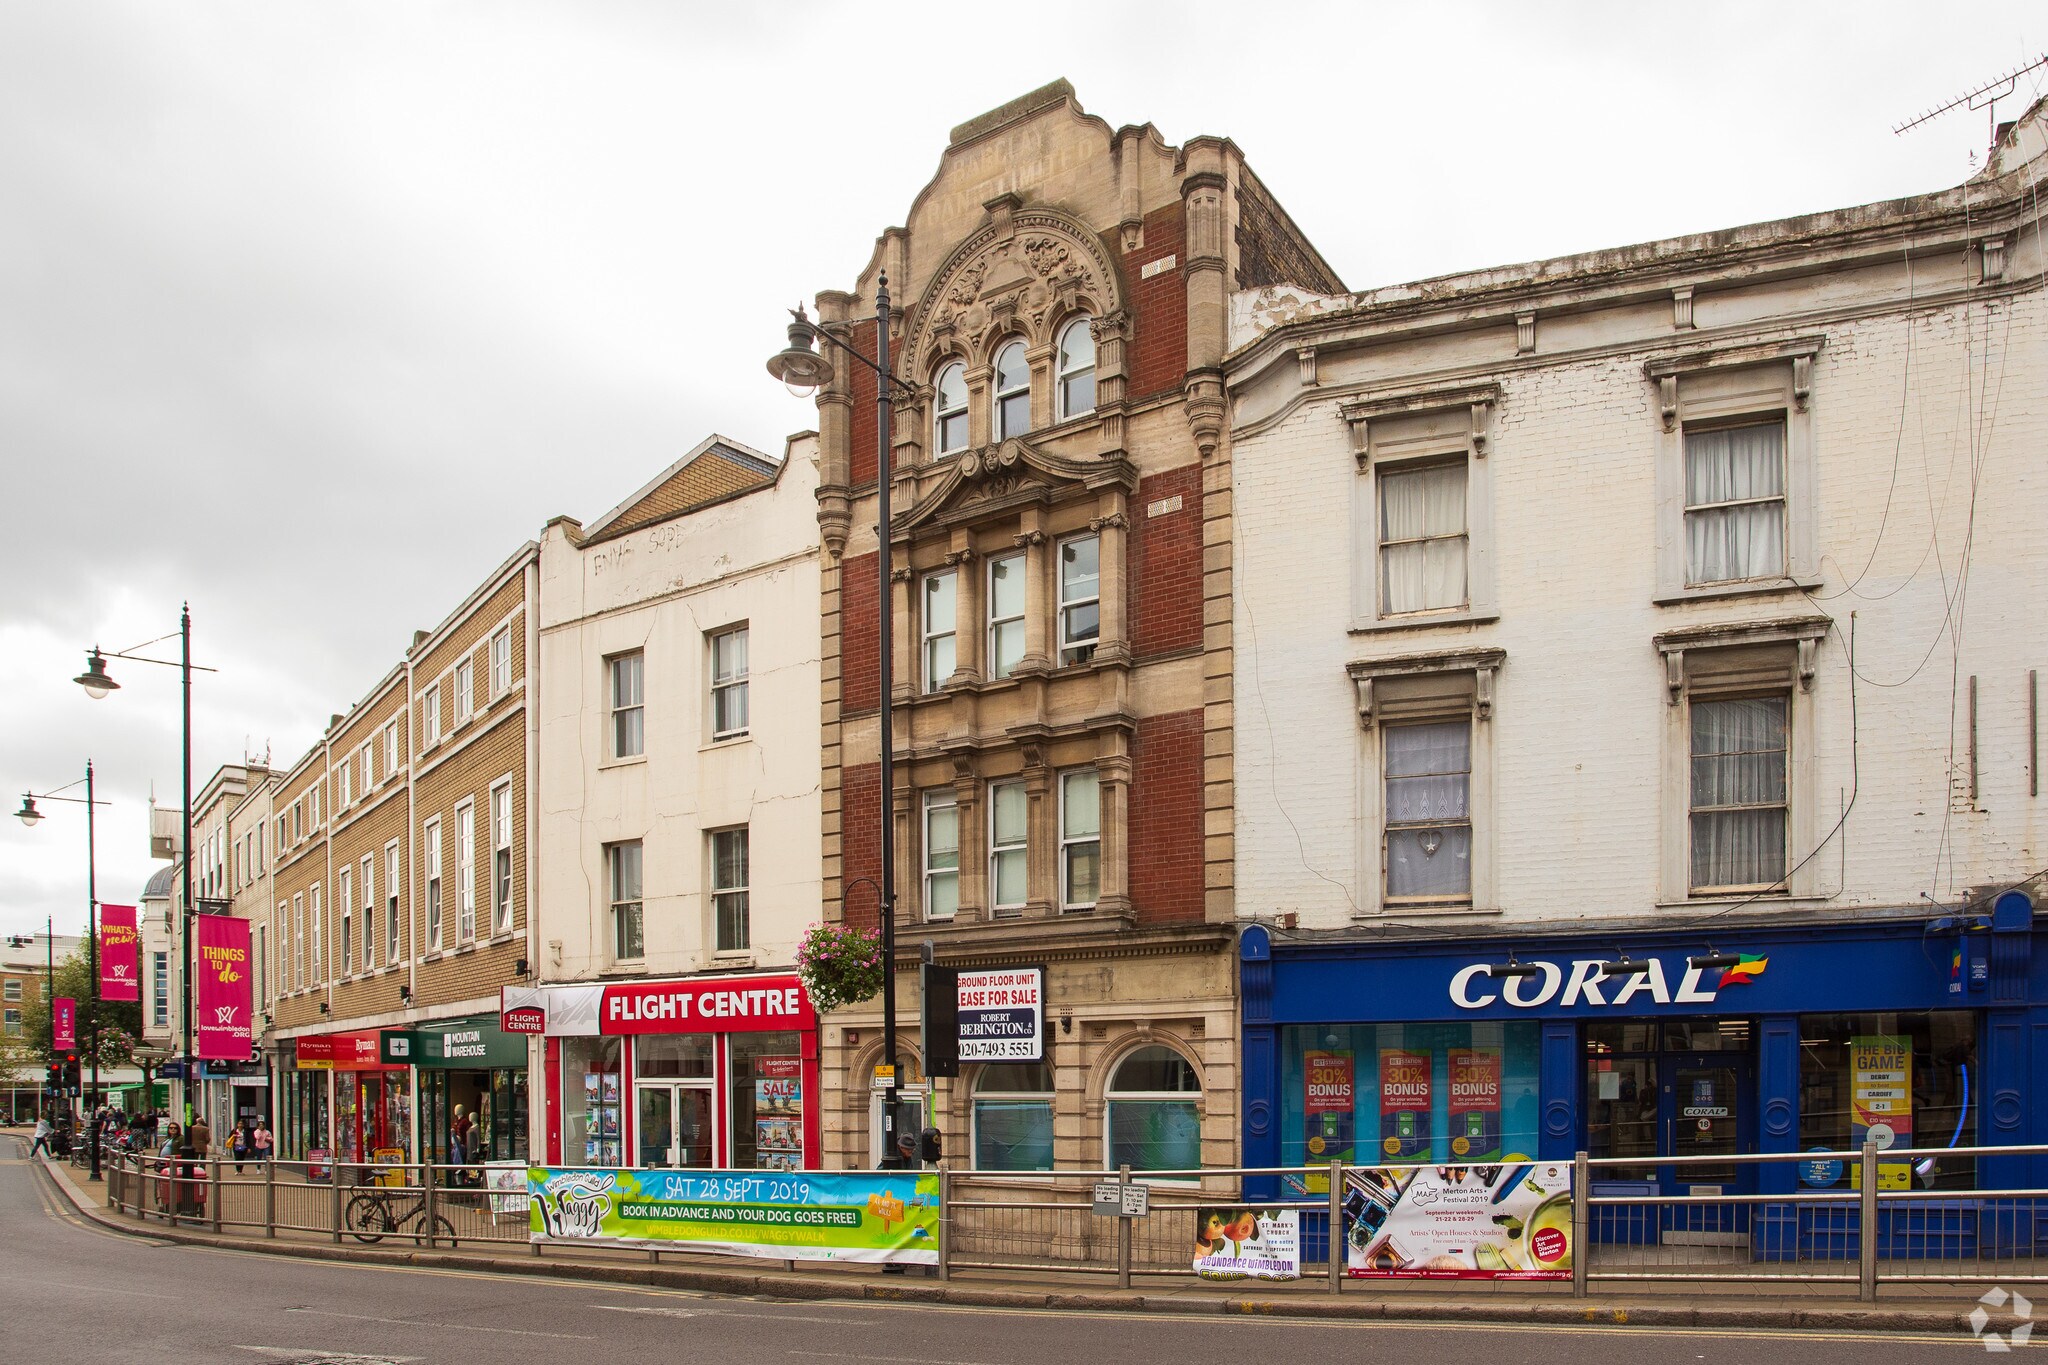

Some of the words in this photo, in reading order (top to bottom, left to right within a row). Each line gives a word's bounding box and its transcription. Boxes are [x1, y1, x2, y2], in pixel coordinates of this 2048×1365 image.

[102, 925, 132, 934] WHAT'S
[106, 933, 136, 946] new?
[202, 946, 245, 961] THINGS
[211, 960, 222, 969] TO
[219, 963, 242, 983] do
[957, 977, 987, 987] GROUND
[990, 976, 1014, 986] FLOOR
[1016, 974, 1035, 985] UNIT
[1449, 957, 1717, 1008] CORAL
[609, 994, 693, 1020] FLIGHT
[698, 989, 800, 1017] CENTRE
[958, 991, 985, 1007] EASE
[988, 991, 1008, 1005] FOR
[1011, 989, 1037, 1005] SALE
[509, 1015, 540, 1023] FLIGHT
[980, 1013, 1010, 1022] ROBERT
[508, 1022, 541, 1030] CENTRE
[960, 1022, 1024, 1035] BEBINGTON
[452, 1031, 480, 1043] MOUNTAIN
[355, 1039, 376, 1053] Ryman
[452, 1044, 486, 1057] WAREHOUSE
[959, 1042, 1006, 1057] 020-7493
[1009, 1042, 1034, 1056] 5551
[1857, 1045, 1879, 1055] THE
[1884, 1045, 1906, 1055] BIG
[1857, 1056, 1905, 1070] GAME
[1312, 1068, 1347, 1084] 30%
[1387, 1067, 1424, 1083] 30%
[1455, 1067, 1493, 1083] 30%
[763, 1082, 795, 1096] SALE
[1308, 1084, 1351, 1096] BONUS
[1384, 1083, 1428, 1096] BONUS
[1452, 1083, 1497, 1095] BONUS
[546, 1172, 584, 1192] Wimbledon
[584, 1173, 601, 1188] Guild
[665, 1176, 696, 1199] SAT
[700, 1178, 720, 1198] 28
[723, 1178, 765, 1202] SEPT
[769, 1181, 810, 1204] 2019
[531, 1184, 608, 1238] Waggy
[623, 1205, 649, 1217] BOOK
[650, 1206, 661, 1217] IN
[661, 1206, 710, 1219] ADVANCE
[711, 1208, 735, 1220] AND
[736, 1209, 765, 1221] YOUR
[767, 1210, 791, 1222] DOG
[794, 1211, 825, 1223] GOES
[827, 1212, 856, 1224] FREE!
[646, 1225, 825, 1242] WIMBLEDONGUILD.CO.UK/WAGGYWALK
[1431, 1229, 1449, 1237] Open
[1535, 1232, 1559, 1243] Discover
[1537, 1242, 1562, 1252] Discover
[1539, 1248, 1559, 1257] Merton
